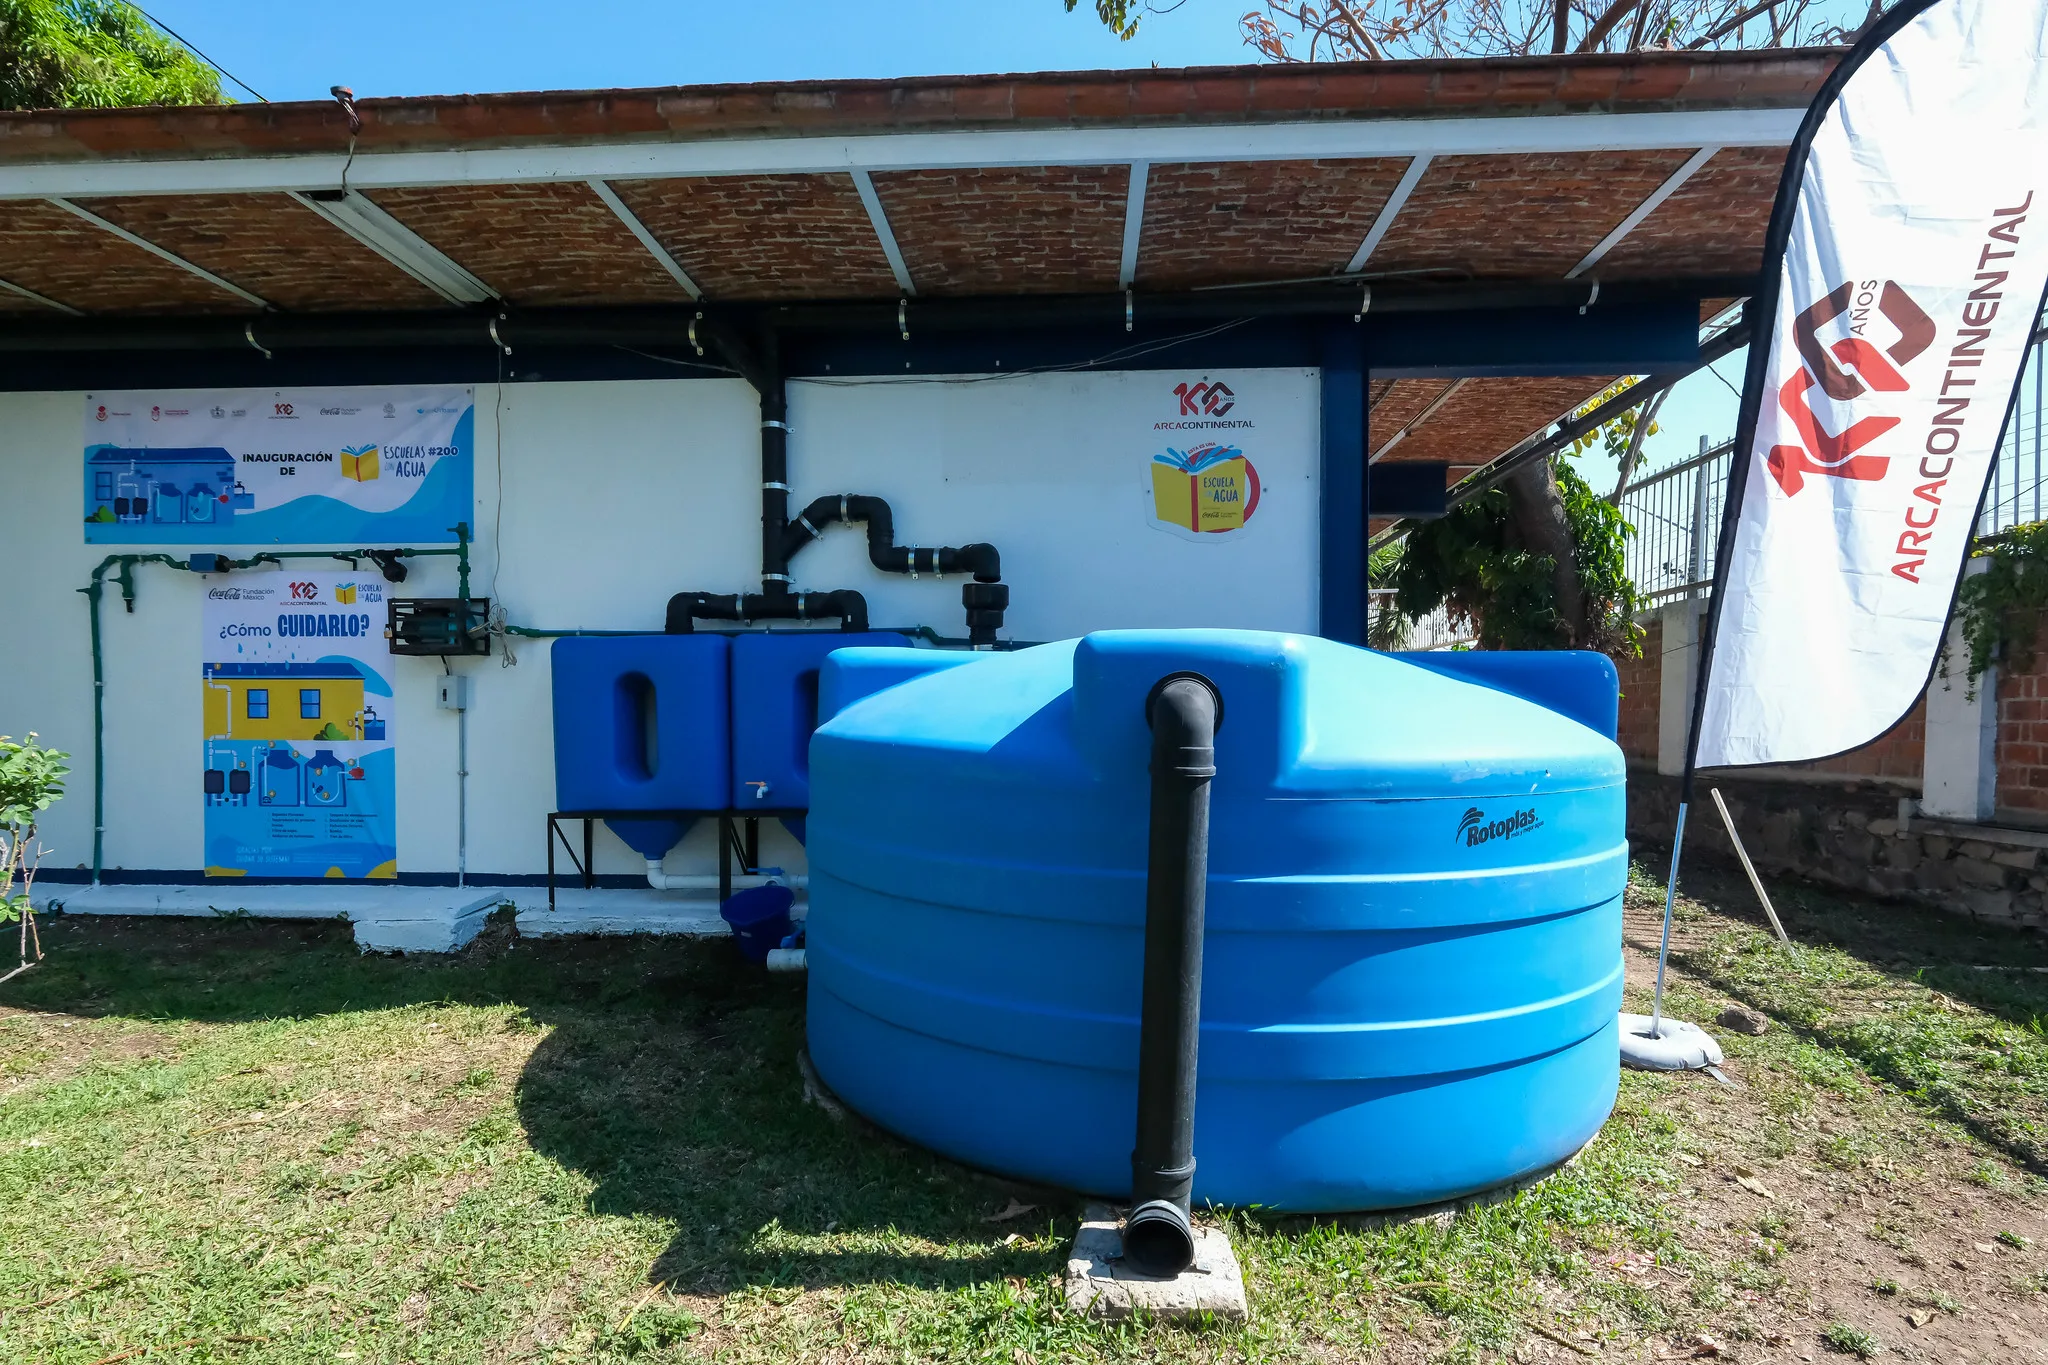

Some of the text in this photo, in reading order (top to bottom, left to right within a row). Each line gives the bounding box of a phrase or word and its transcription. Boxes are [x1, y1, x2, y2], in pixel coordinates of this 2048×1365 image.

[1850, 278, 1879, 335] AÑOS
[1889, 189, 2034, 585] ARCACONTINENTAL
[1153, 420, 1255, 430] ARCACONTINENTAL
[242, 451, 333, 462] INAUGURACIÓN
[384, 446, 458, 459] ESCUELAS #200
[280, 467, 296, 476] DE
[396, 461, 426, 477] AGUA
[1203, 477, 1234, 488] ESCUELA
[1213, 489, 1238, 502] AGUA
[358, 584, 382, 593] ESCUELAS
[365, 592, 382, 603] AGUA
[219, 613, 370, 638] ¿Cómo CUIDARLO?
